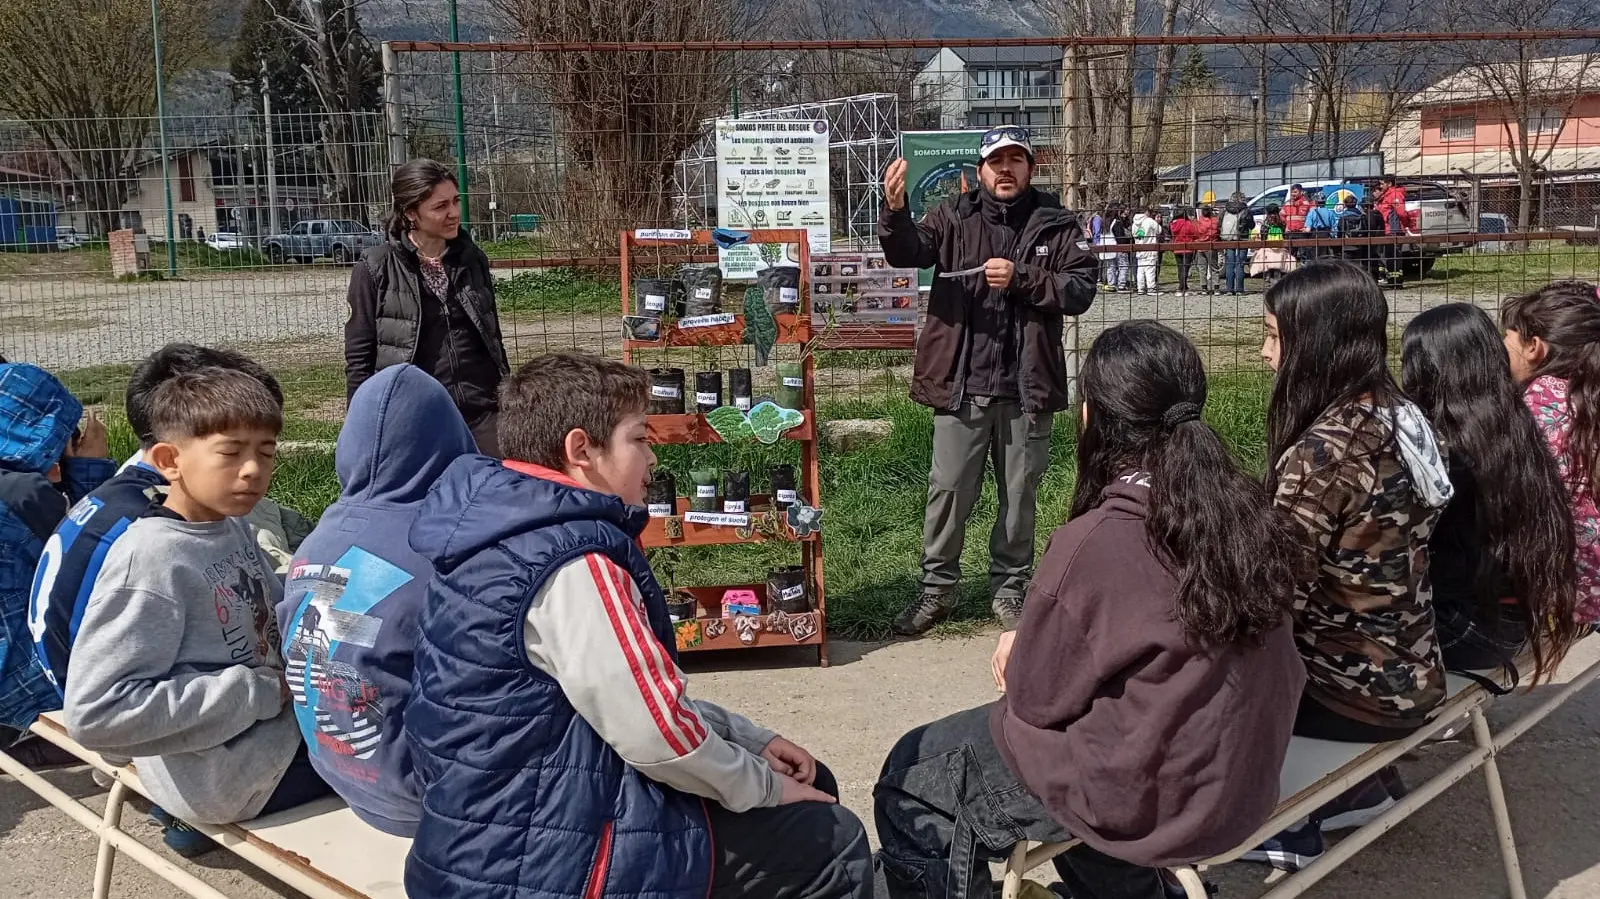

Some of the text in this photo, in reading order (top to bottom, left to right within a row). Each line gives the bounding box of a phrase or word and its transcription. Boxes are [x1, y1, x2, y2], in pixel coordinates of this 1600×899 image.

[735, 123, 810, 132] SOMOS PARTE DEL BOSQUE
[941, 148, 964, 156] PARTE
[740, 168, 760, 176] Gracias
[689, 514, 719, 523] protegen
